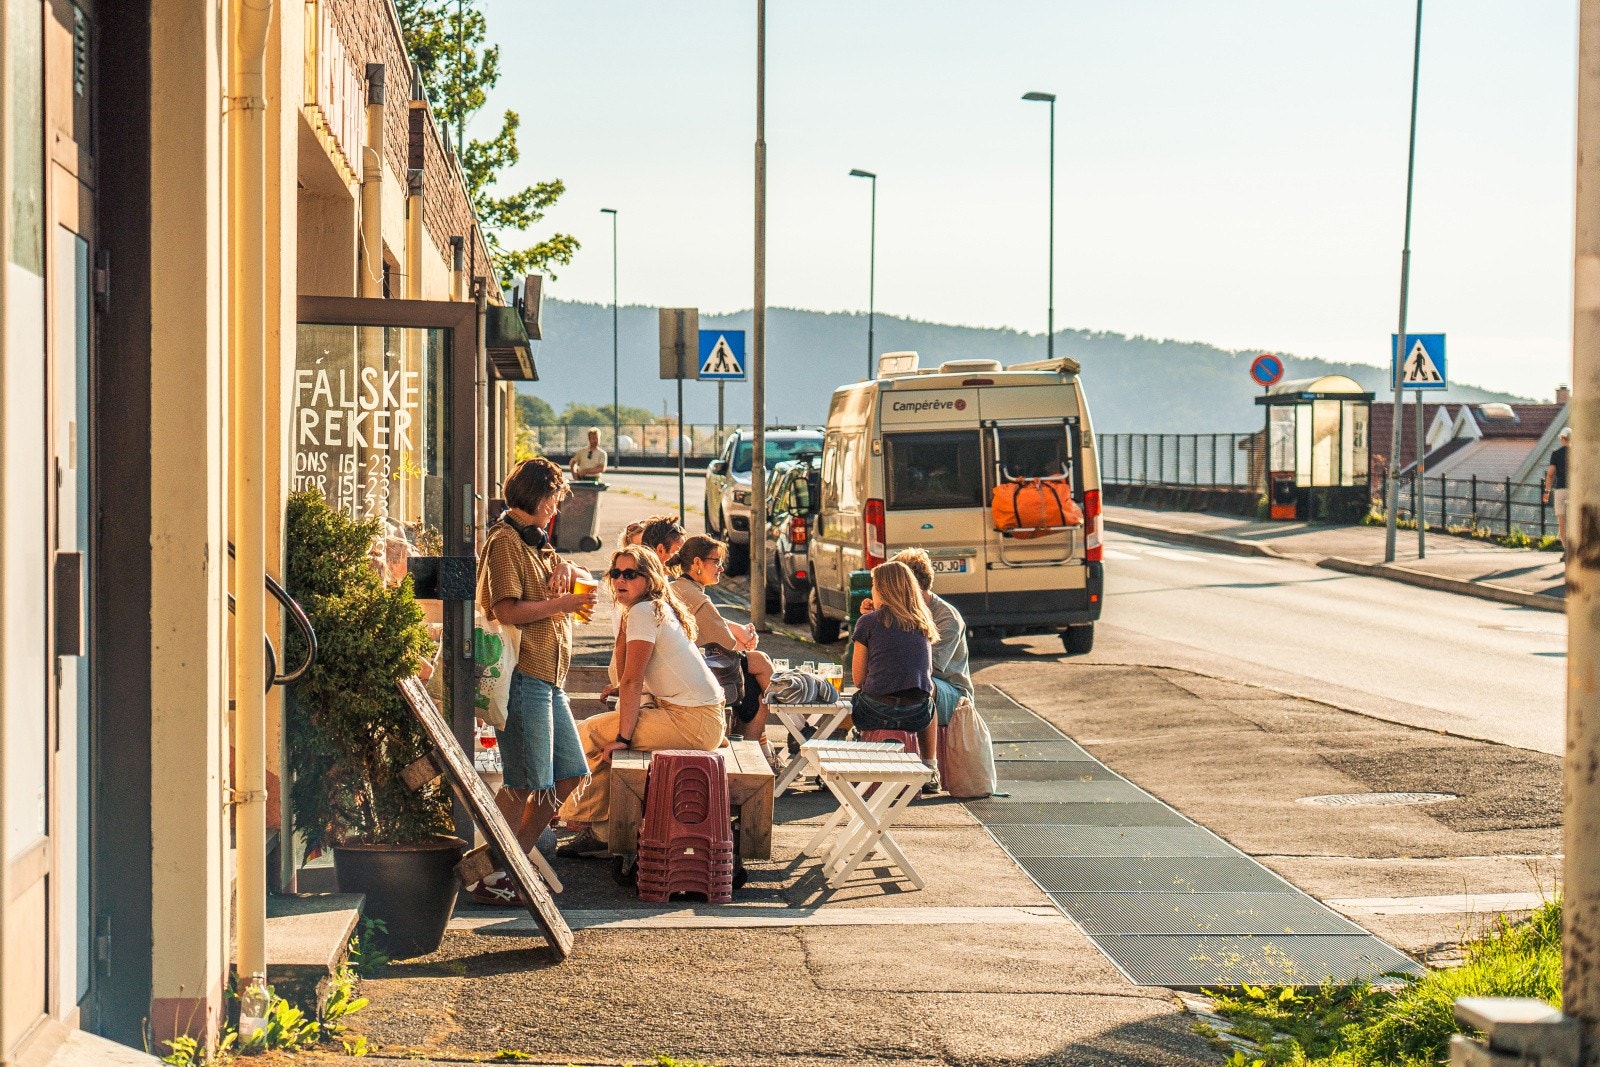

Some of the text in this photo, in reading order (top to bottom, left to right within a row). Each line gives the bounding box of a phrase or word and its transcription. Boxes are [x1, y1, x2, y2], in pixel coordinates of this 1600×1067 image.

[295, 367, 419, 410] FALSKE
[300, 408, 414, 451] REKER
[295, 451, 328, 472] ONS
[294, 474, 327, 495] TOR
